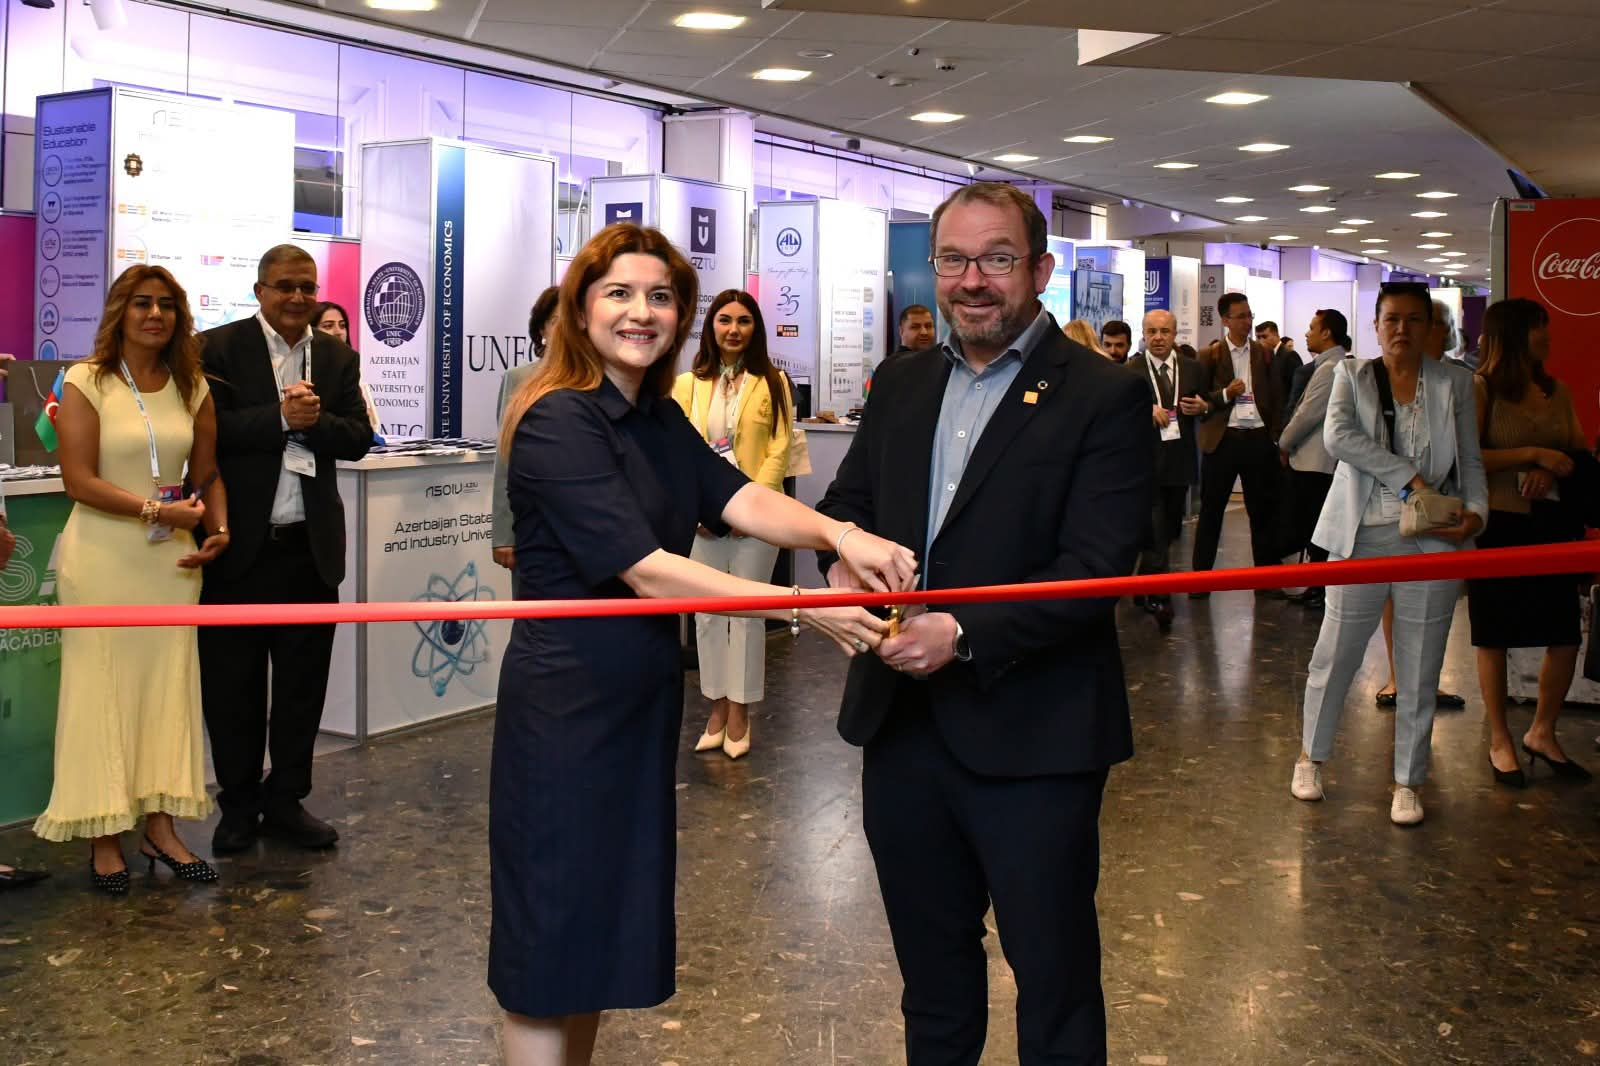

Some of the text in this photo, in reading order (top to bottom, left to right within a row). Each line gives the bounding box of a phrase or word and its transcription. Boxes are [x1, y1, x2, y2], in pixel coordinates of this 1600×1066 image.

[443, 220, 453, 305] ECONOMICS
[776, 286, 800, 316] 35
[443, 309, 451, 328] OF
[369, 356, 420, 366] AZERBAIJAN
[382, 370, 407, 379] STATE
[441, 331, 451, 414] UNIVERSITY
[368, 384, 413, 393] NIVERSITY
[373, 398, 419, 408] CONOMICS
[395, 512, 493, 534] Azerbaijan State
[384, 529, 493, 553] and Industry Unive
